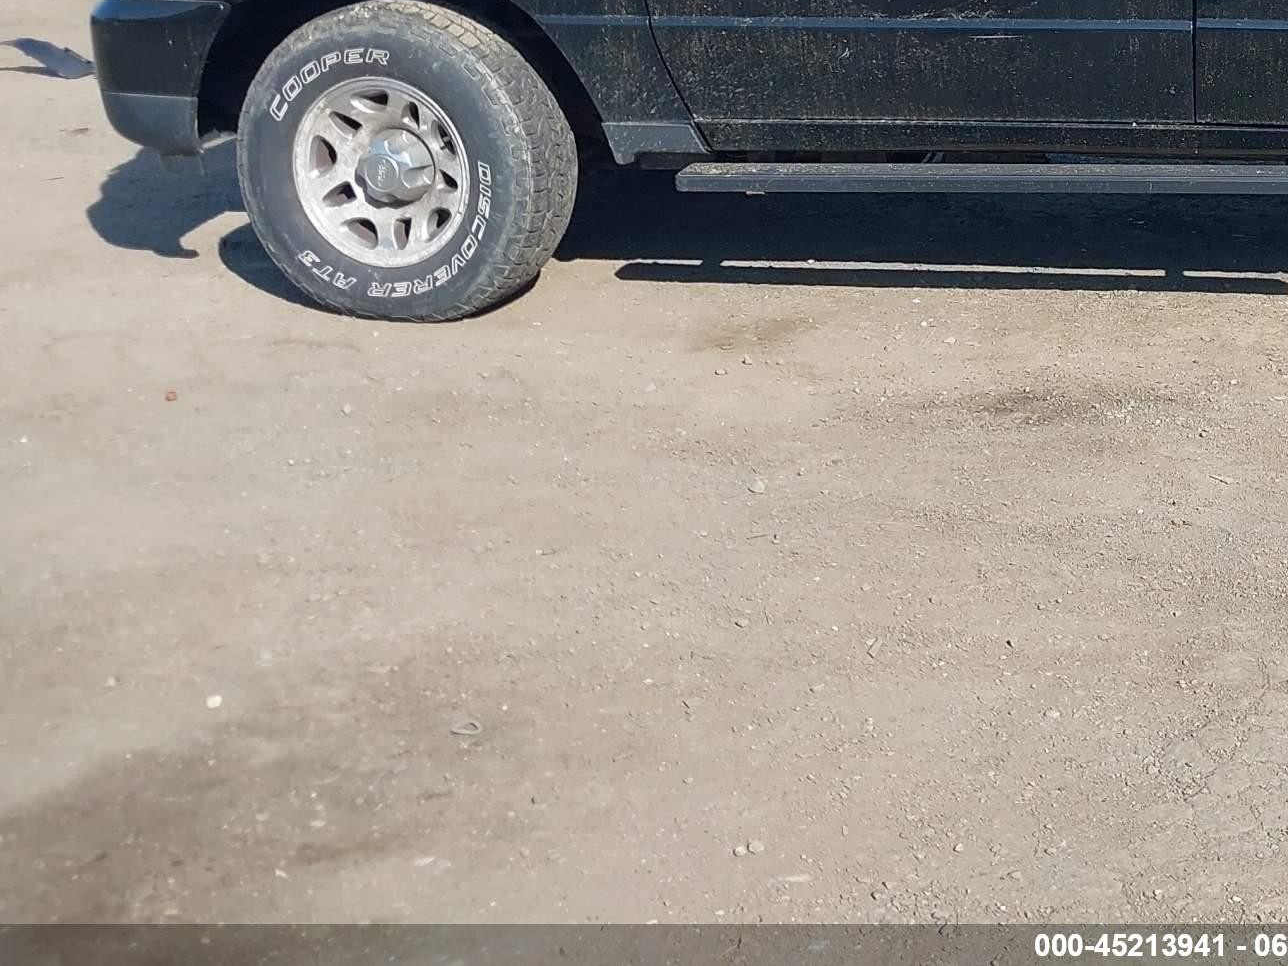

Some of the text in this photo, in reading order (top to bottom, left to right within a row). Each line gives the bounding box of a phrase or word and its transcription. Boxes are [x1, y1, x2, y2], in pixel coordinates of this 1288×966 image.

[270, 48, 390, 121] COOPER
[299, 161, 491, 297] DISCOVERER AT3
